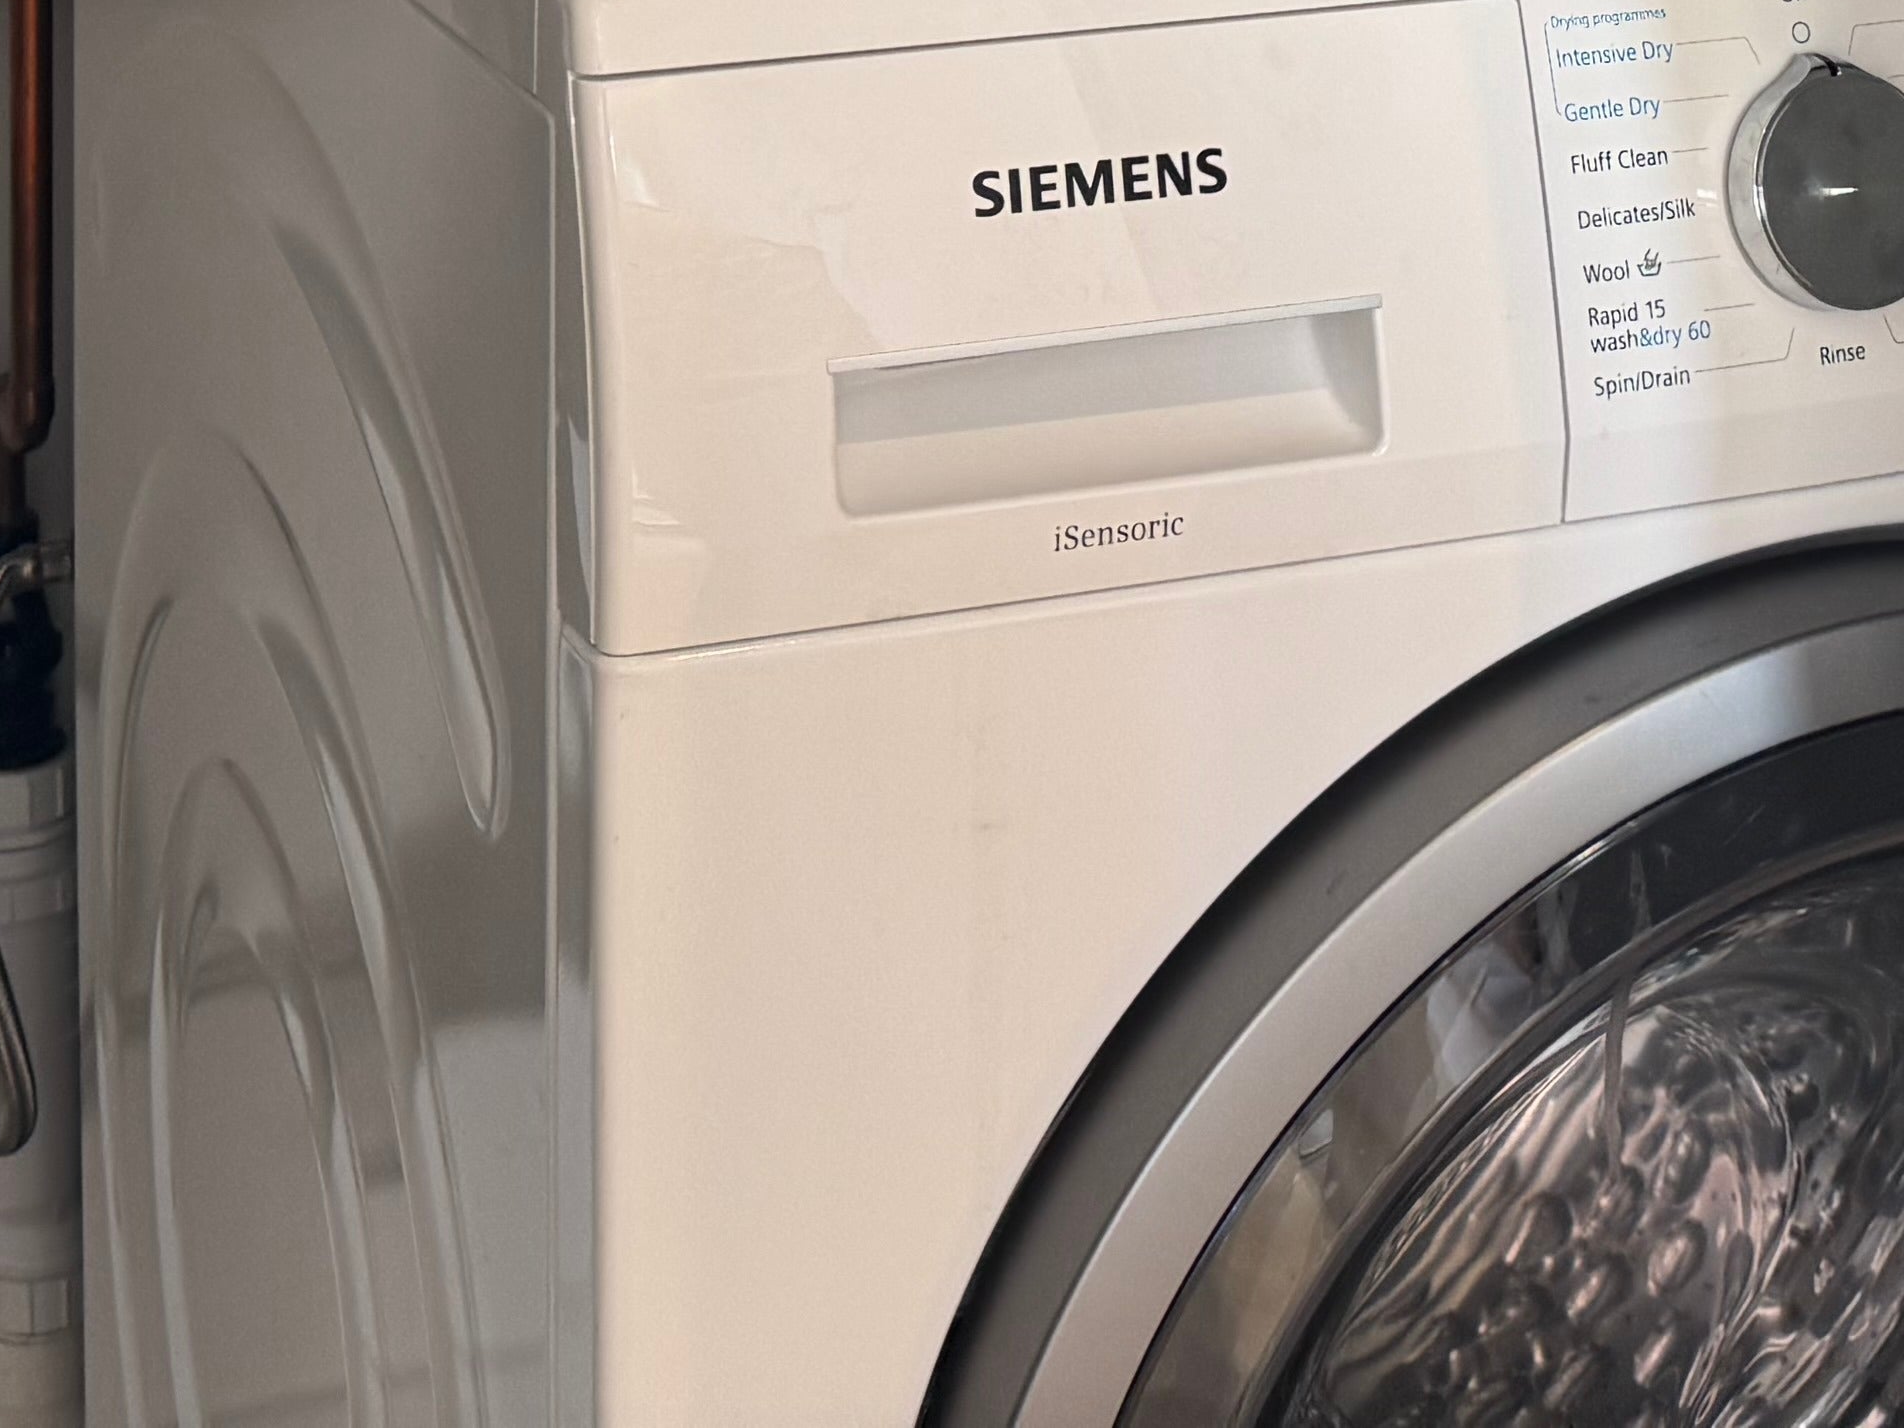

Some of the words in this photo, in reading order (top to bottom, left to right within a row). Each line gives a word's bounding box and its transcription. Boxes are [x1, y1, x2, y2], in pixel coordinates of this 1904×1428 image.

[1550, 13, 1590, 30] Drying
[1592, 8, 1666, 28] programmes
[1556, 45, 1638, 69] Intensive
[1641, 40, 1674, 65] Dry
[1564, 98, 1625, 122] Gentle
[1628, 96, 1661, 120] Dry
[1570, 152, 1615, 174] Fluff
[1618, 146, 1668, 170] Clean
[972, 148, 1228, 218] SIEMENS
[1577, 198, 1696, 230] Delicates/Silk
[1583, 260, 1631, 285] Wool
[1588, 302, 1640, 332] Rapid
[1645, 299, 1666, 320] 15
[1590, 324, 1682, 355] wash&dry
[1688, 320, 1711, 342] 60
[1820, 343, 1866, 366] Rinse
[1594, 366, 1691, 399] Spin/Drain
[1054, 512, 1185, 552] iSensoric
